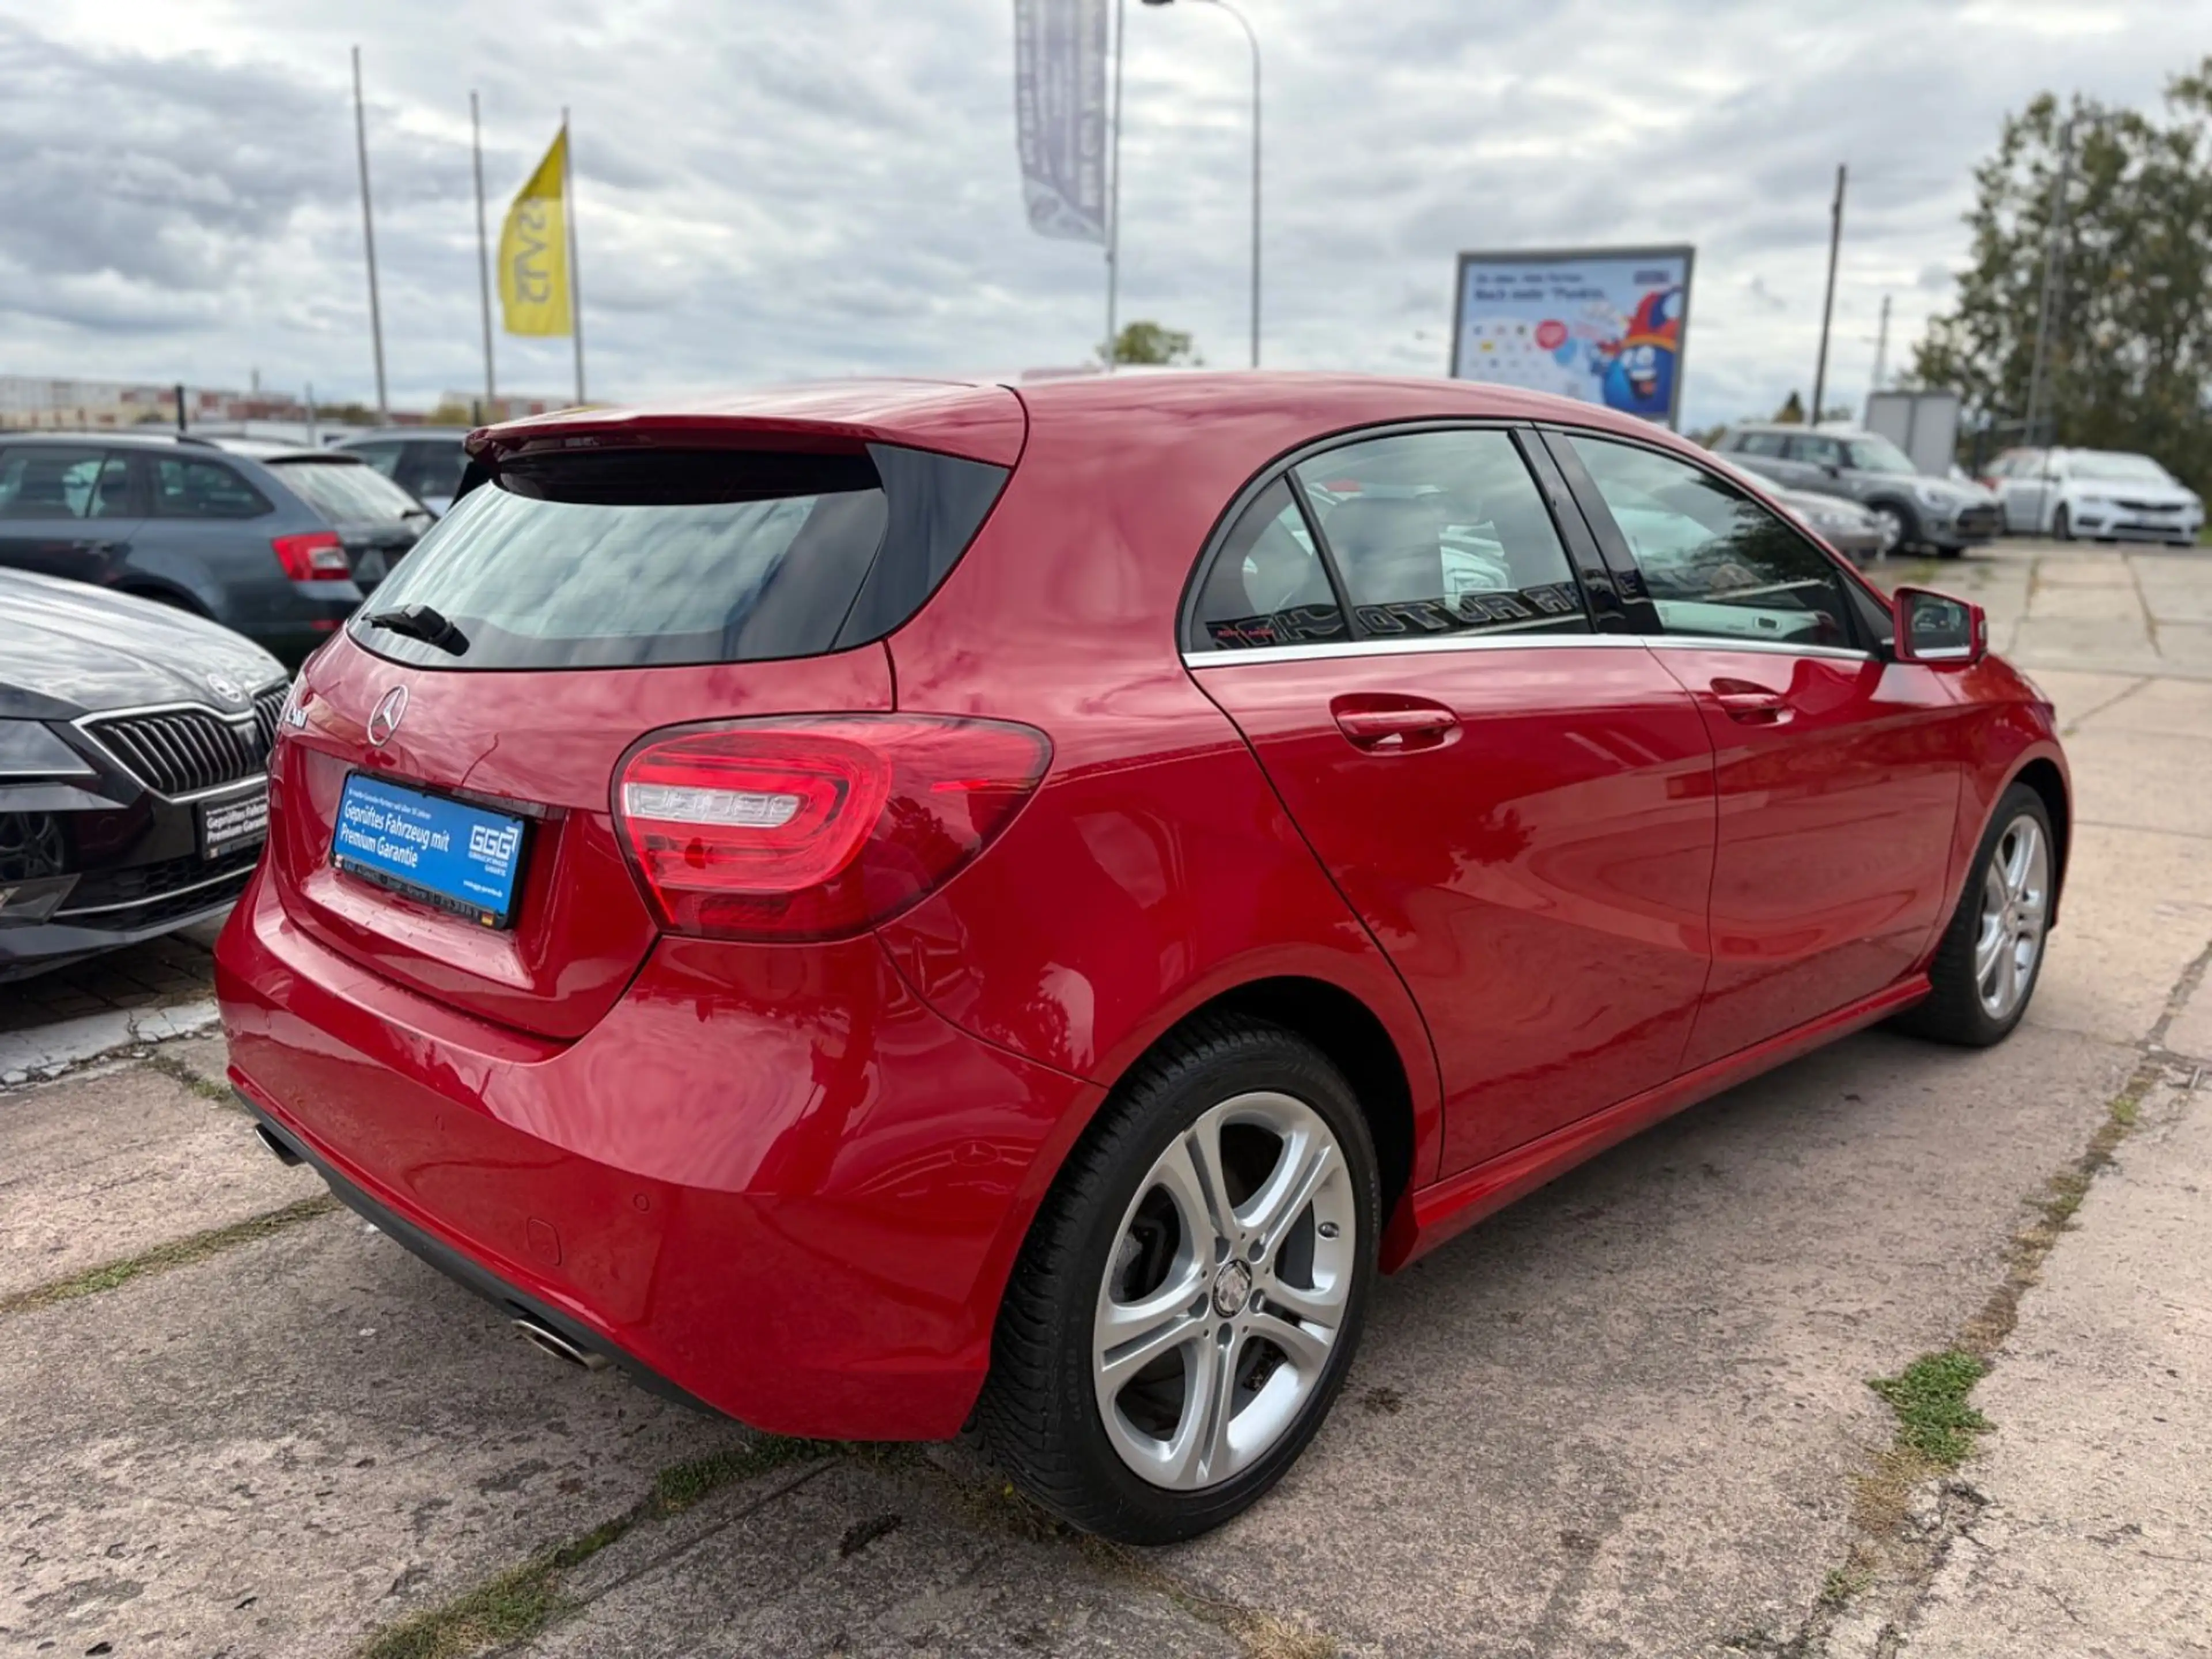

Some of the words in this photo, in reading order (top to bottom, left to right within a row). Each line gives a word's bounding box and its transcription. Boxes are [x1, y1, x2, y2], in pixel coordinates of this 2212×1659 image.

[340, 821, 377, 853] Premium
[377, 836, 418, 869] Garantie
[344, 799, 385, 830] Geprüftes
[384, 812, 430, 851] Fahrzeug
[430, 830, 450, 853] mit
[469, 824, 514, 861] GGG
